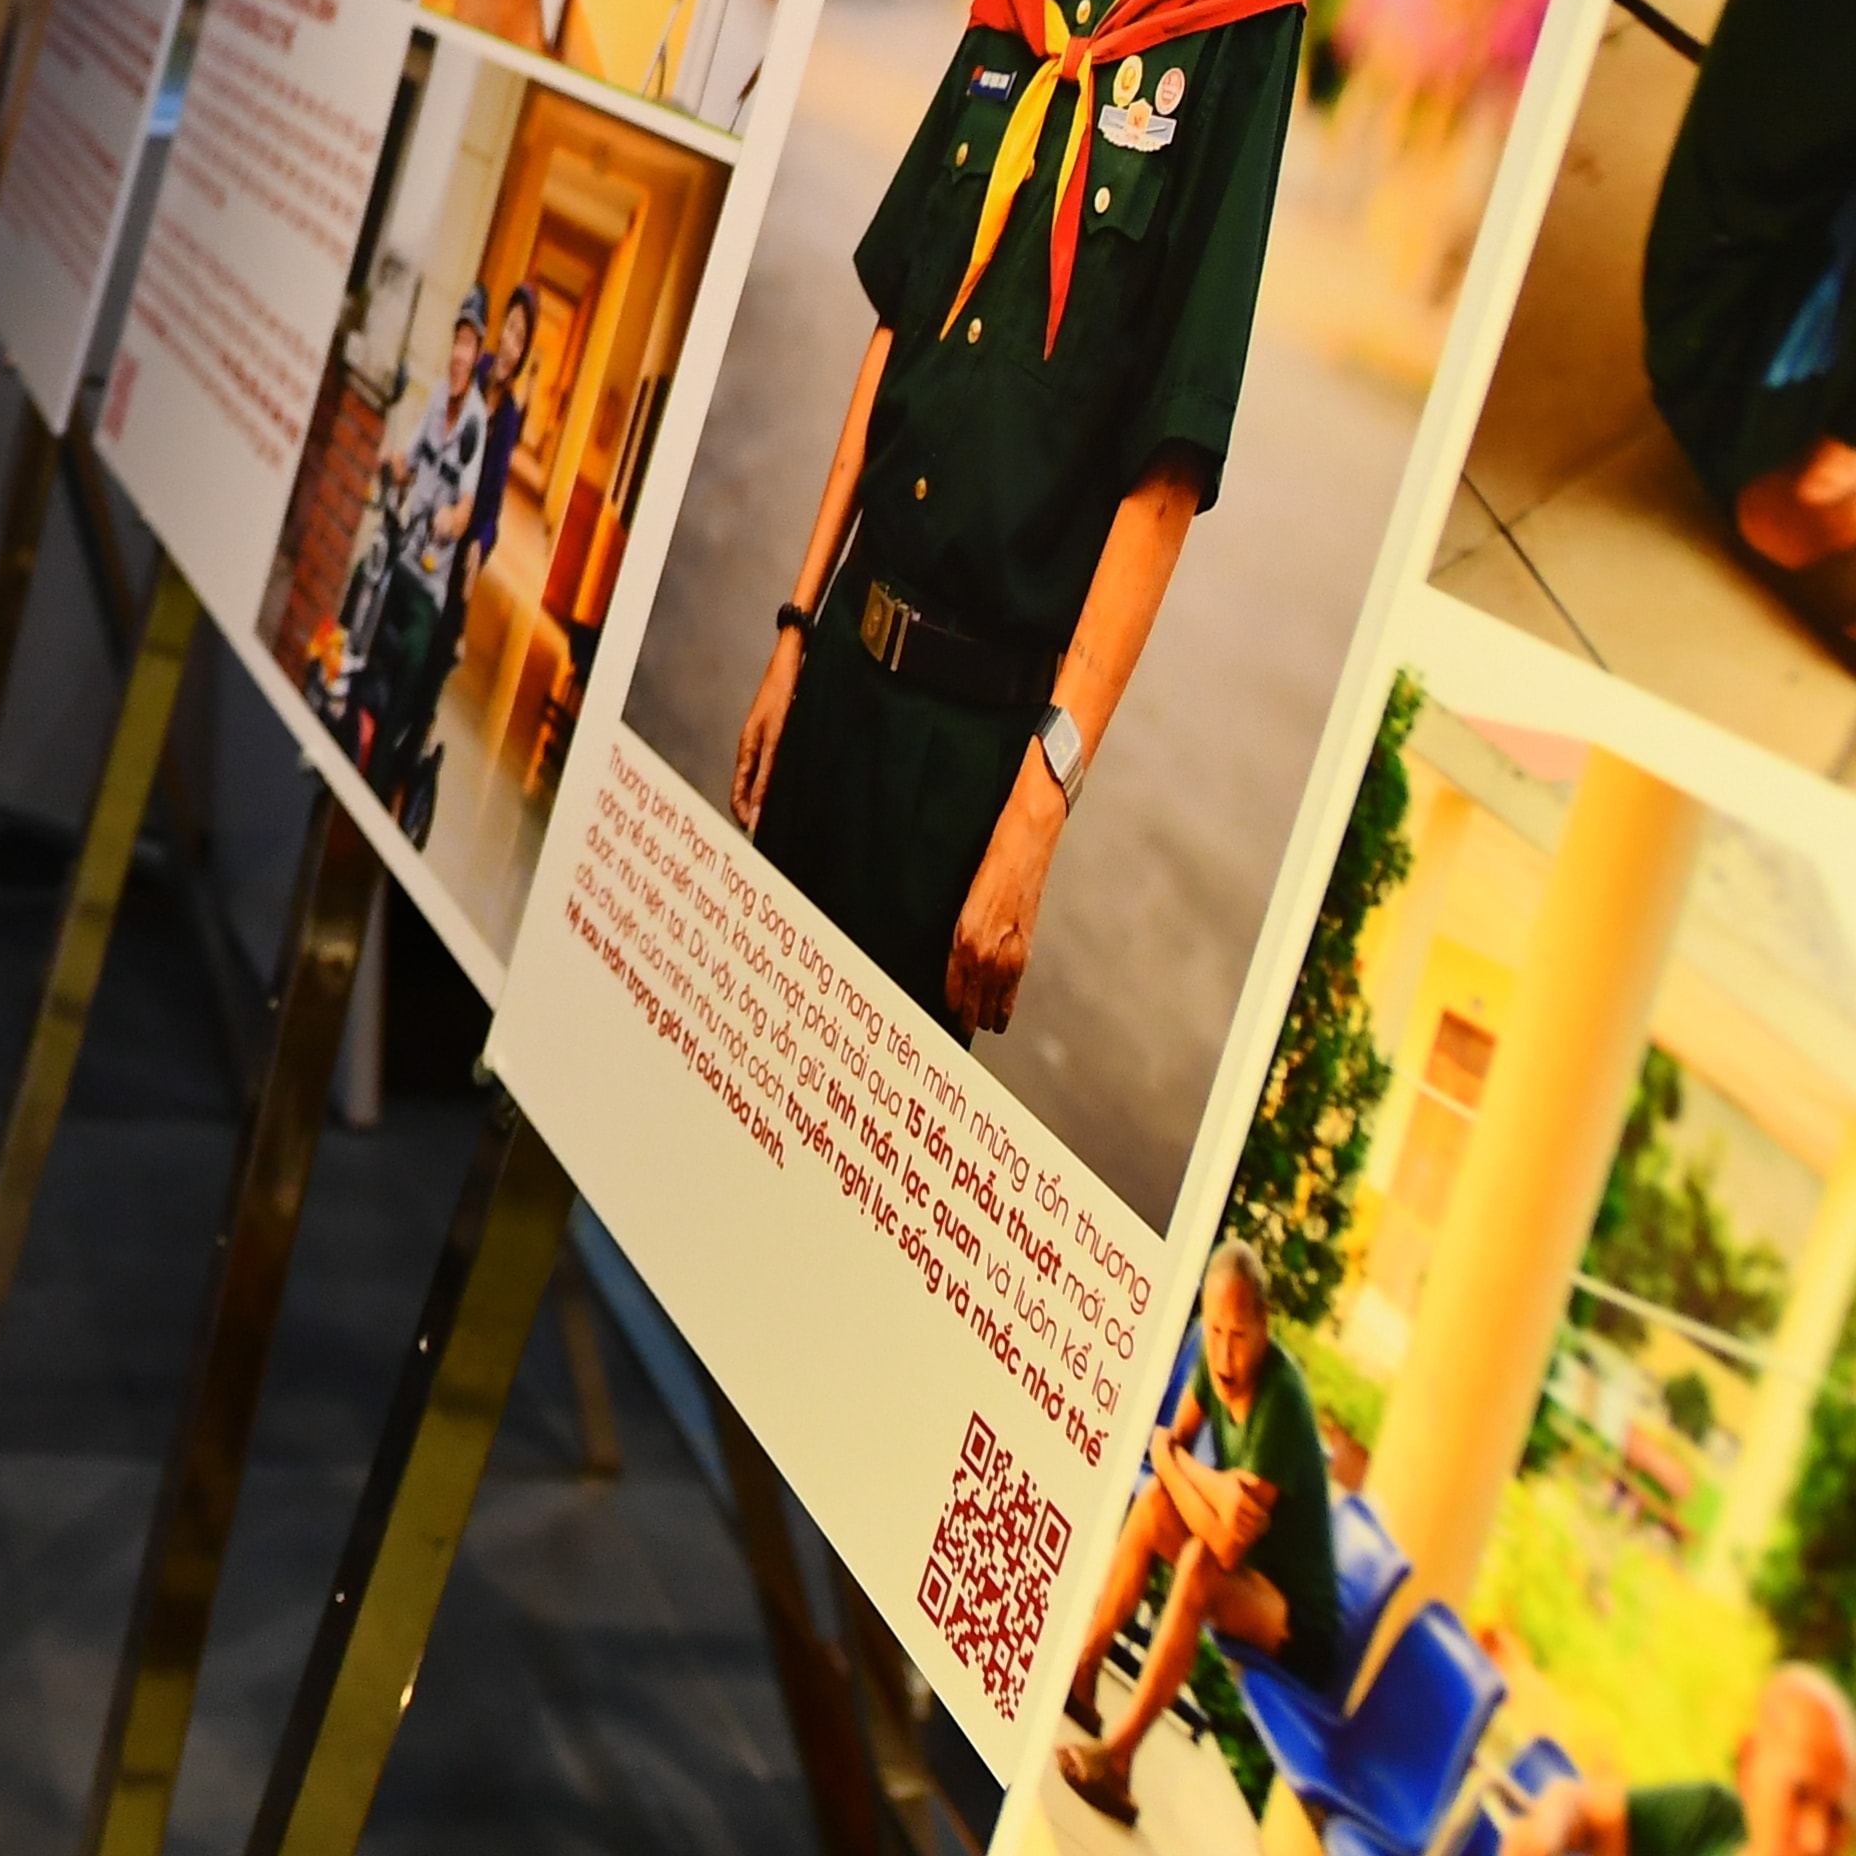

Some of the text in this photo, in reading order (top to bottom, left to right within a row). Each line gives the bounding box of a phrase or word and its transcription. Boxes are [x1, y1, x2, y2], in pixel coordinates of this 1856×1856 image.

[609, 743, 651, 812] Thương
[678, 815, 718, 872] Phạm
[720, 852, 757, 918] Trọng
[757, 893, 797, 958] Song
[798, 935, 835, 996] từng
[835, 977, 884, 1045] mang
[886, 1022, 921, 1077] trên
[969, 1110, 1031, 1194] những
[1034, 1169, 1069, 1227] tổn
[1074, 1209, 1152, 1316] thương
[626, 966, 661, 1025] trọng
[681, 1029, 700, 1071] trị
[721, 1073, 752, 1127] hòa
[642, 835, 661, 866] do
[731, 919, 774, 984] khuôn
[772, 971, 806, 1018] mặt
[801, 1002, 843, 1053] phải
[840, 1035, 870, 1082] trải
[867, 1069, 903, 1119] qua
[904, 1097, 926, 1139] 15
[922, 1116, 953, 1172] lần
[951, 1157, 1005, 1226] phẫu
[1006, 1206, 1062, 1286] thuật
[1062, 1271, 1106, 1329] mới
[1104, 1309, 1138, 1361] có
[687, 927, 710, 969] Dù
[738, 983, 768, 1039] ông
[796, 1054, 827, 1093] giữ
[826, 1077, 857, 1131] tinh
[860, 1114, 899, 1177] thần
[900, 1154, 931, 1209] lạc
[932, 1199, 981, 1267] quan
[986, 1252, 1012, 1299] và
[1013, 1275, 1058, 1350] luôn
[1060, 1328, 1093, 1381] kể
[1091, 1360, 1122, 1416] lại
[718, 1021, 749, 1068] một
[747, 1055, 785, 1109] cách
[833, 1150, 874, 1215] nghị
[870, 1183, 899, 1237] lực
[898, 1223, 944, 1295] sống
[945, 1273, 971, 1319] và
[970, 1304, 1022, 1376] nhắc
[1021, 1362, 1066, 1422] nhở
[1065, 1405, 1110, 1468] thế
